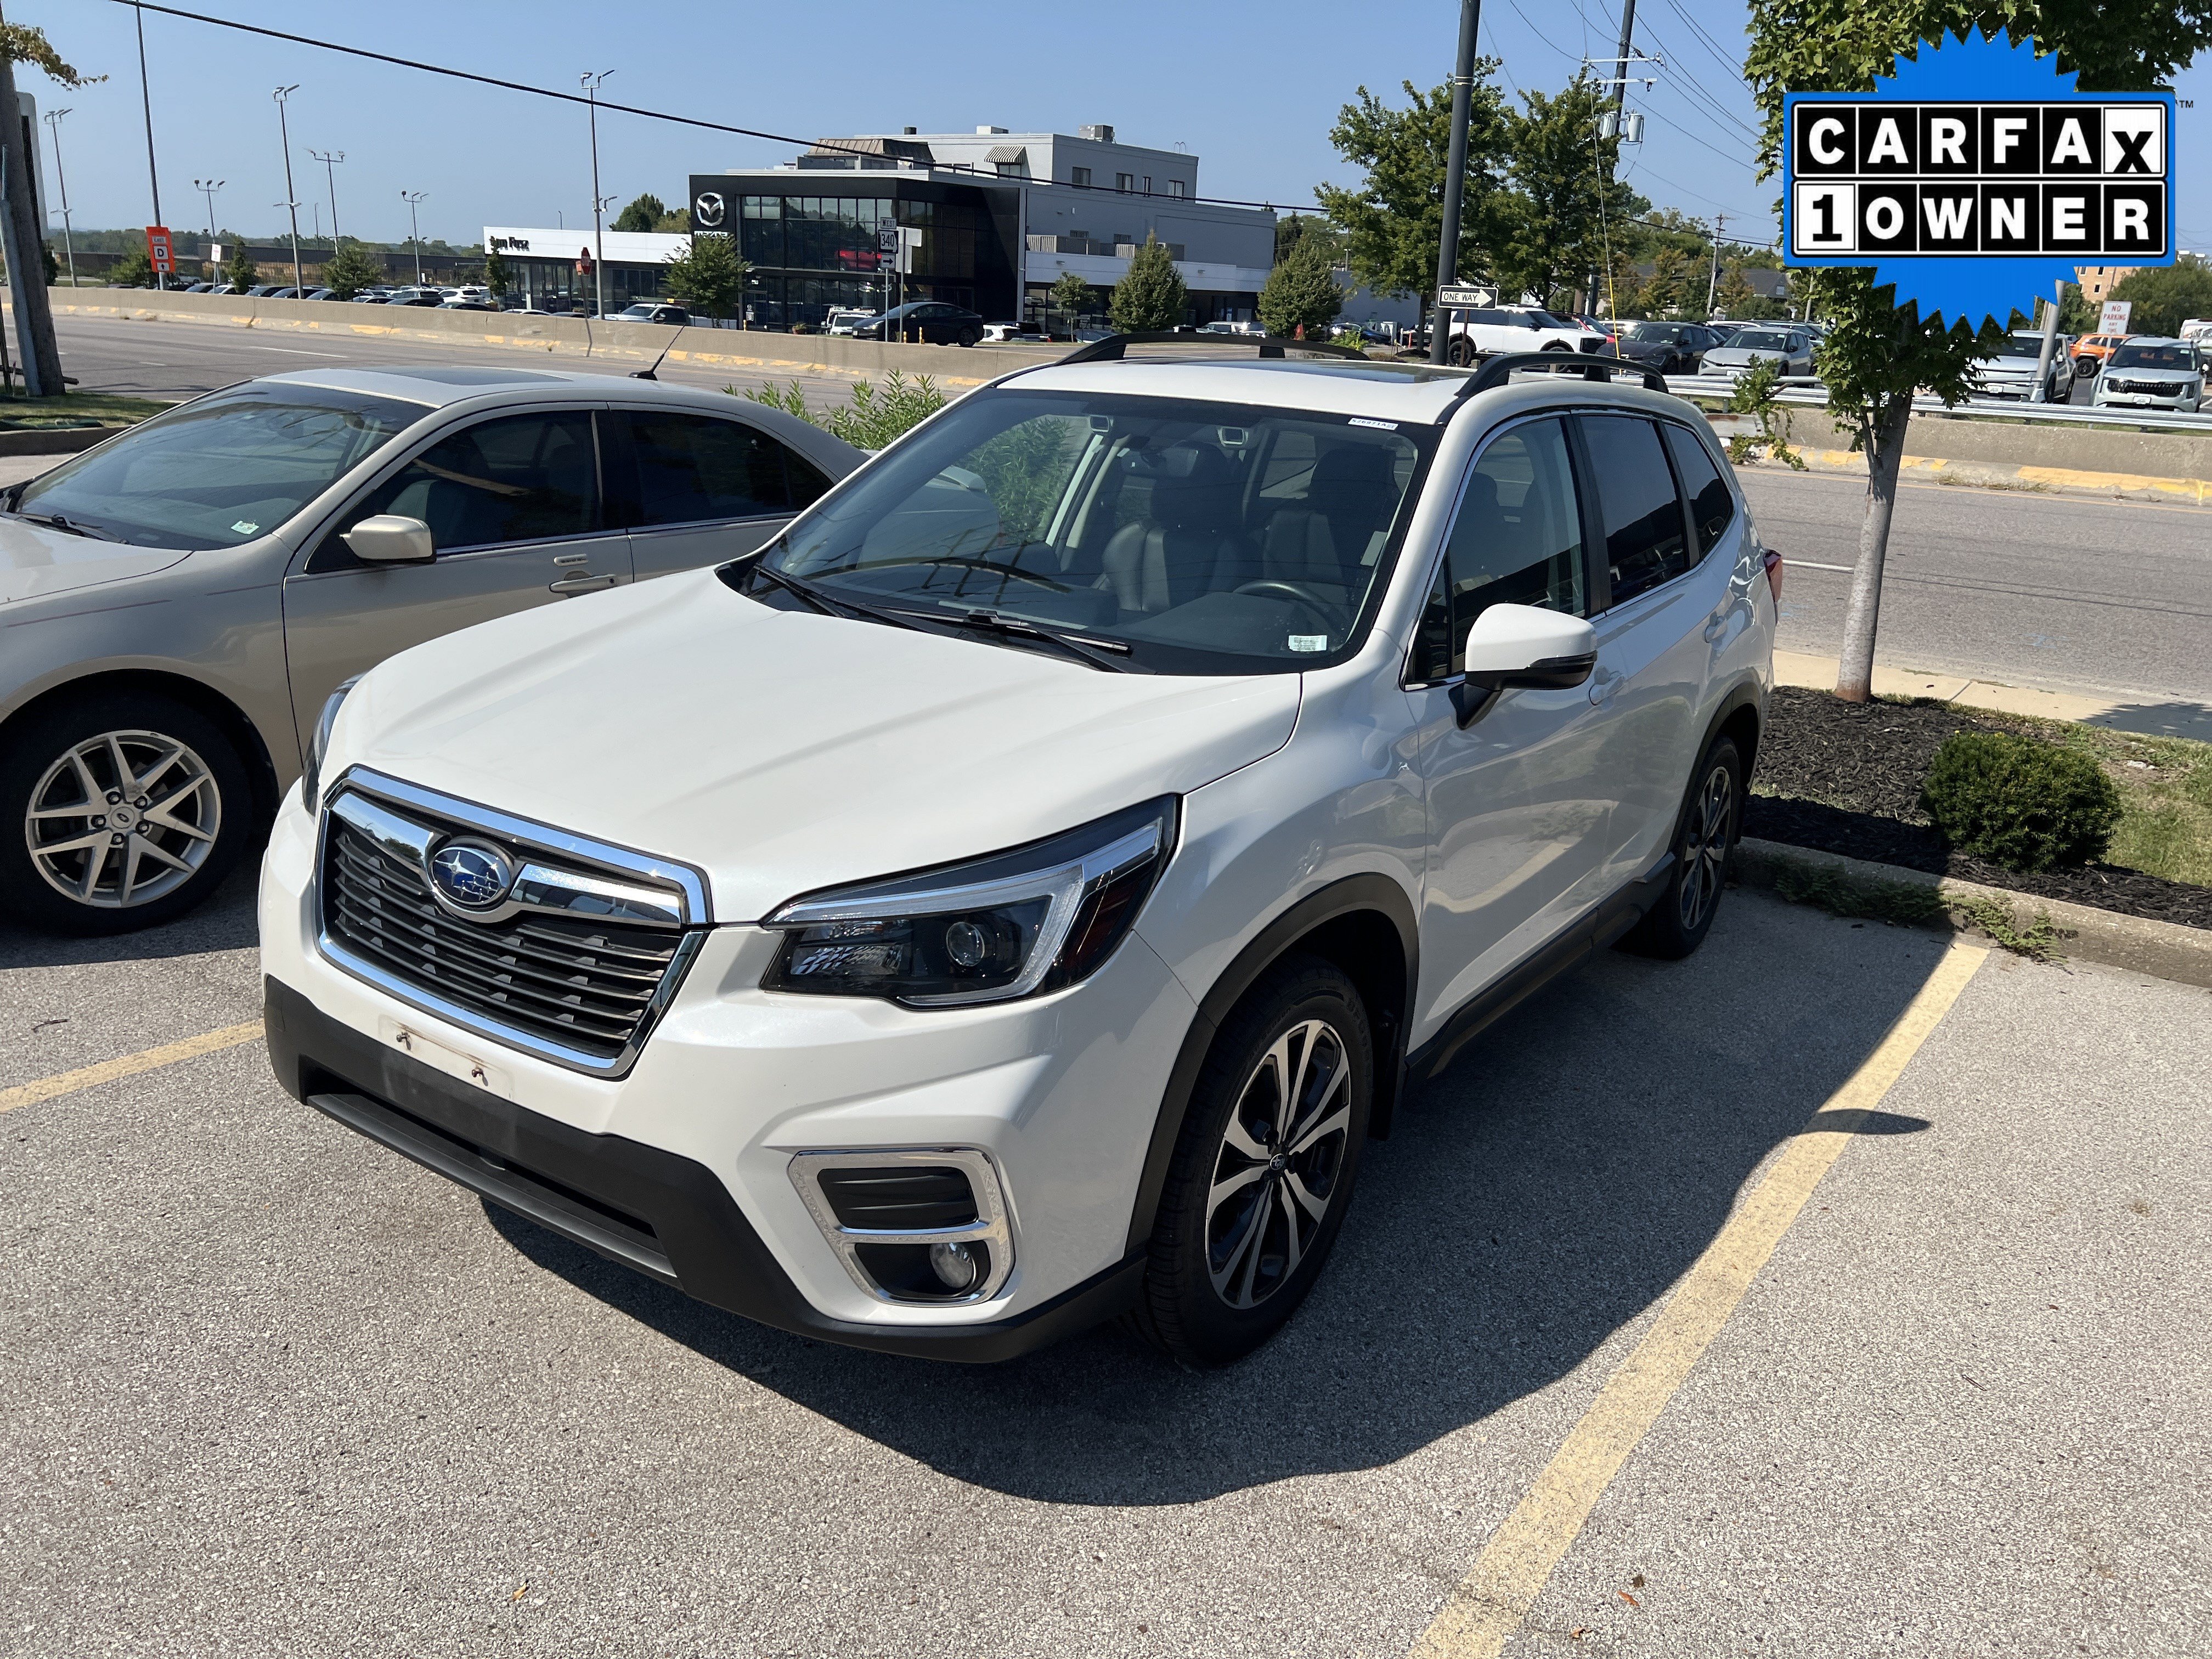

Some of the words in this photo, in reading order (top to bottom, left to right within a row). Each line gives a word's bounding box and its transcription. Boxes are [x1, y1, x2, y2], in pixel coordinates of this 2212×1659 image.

[881, 234, 895, 247] 340
[157, 249, 164, 257] D
[1444, 292, 1459, 301] ONE
[1462, 294, 1478, 302] WAY
